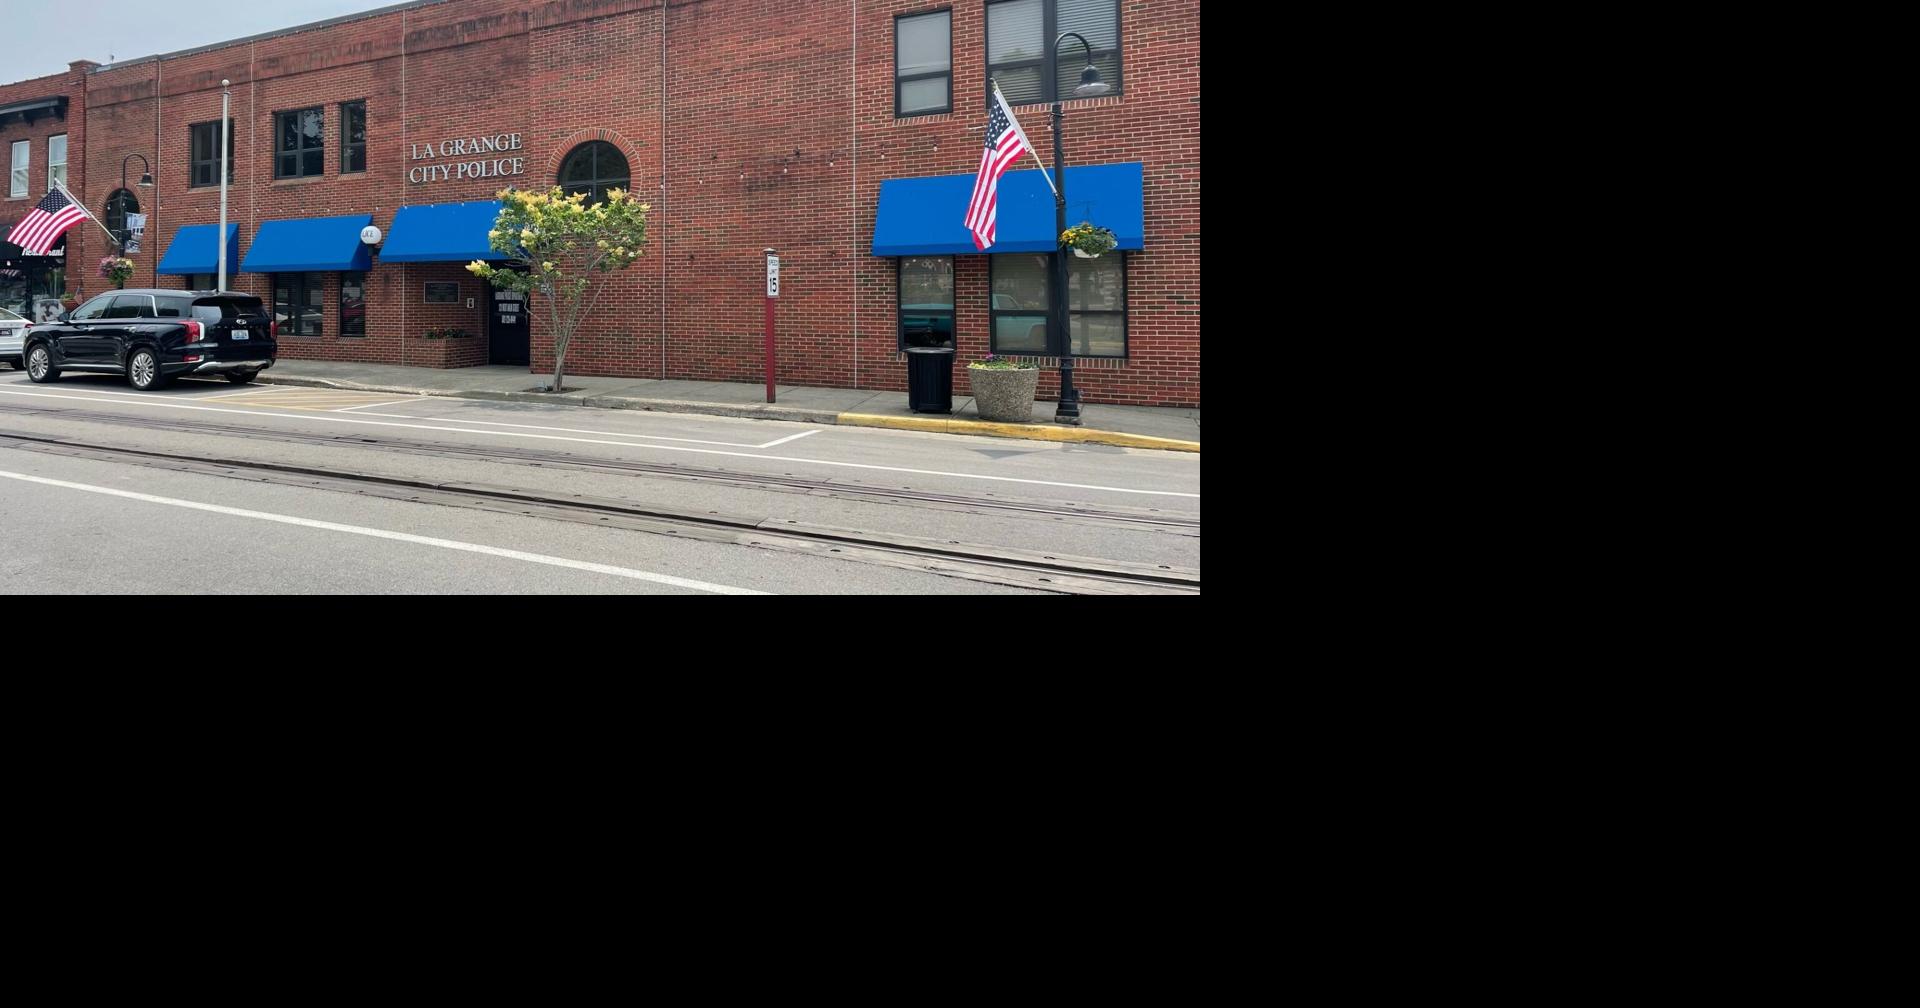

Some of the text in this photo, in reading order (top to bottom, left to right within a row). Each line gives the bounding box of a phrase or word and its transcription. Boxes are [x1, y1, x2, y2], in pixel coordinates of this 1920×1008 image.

[412, 133, 523, 160] LA GRANGE
[409, 157, 524, 183] CITY POLICE
[769, 277, 777, 293] 15
